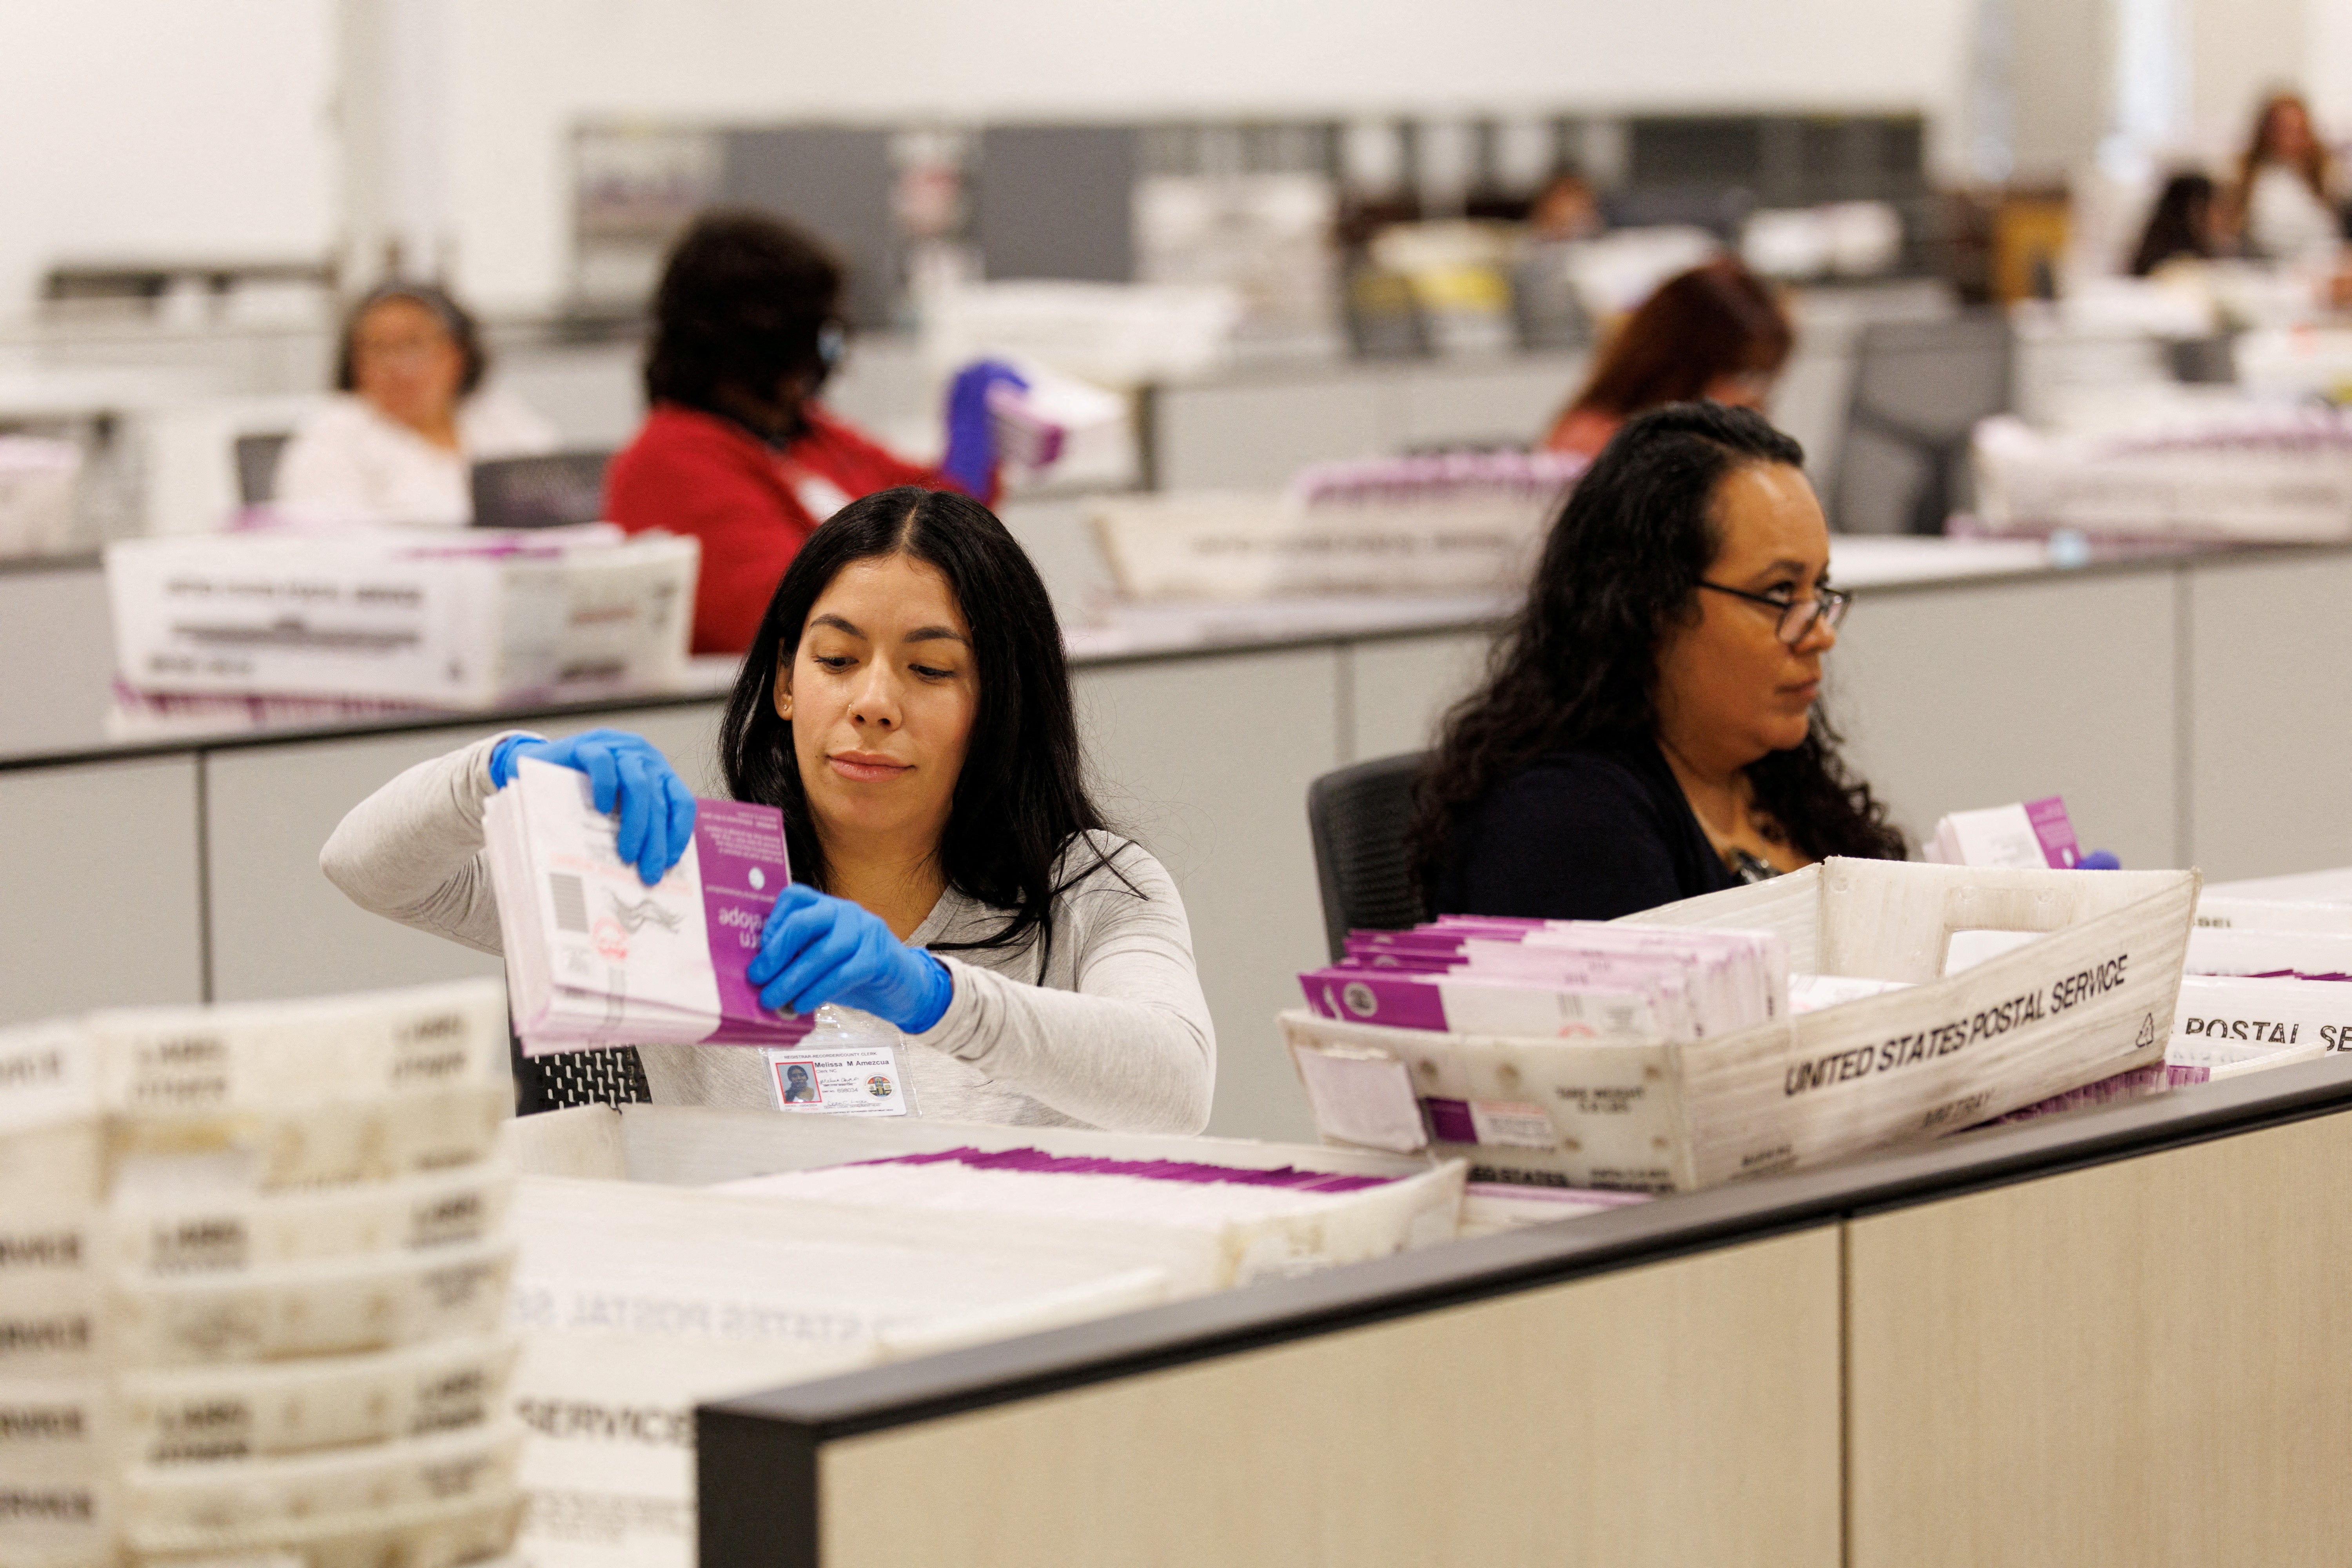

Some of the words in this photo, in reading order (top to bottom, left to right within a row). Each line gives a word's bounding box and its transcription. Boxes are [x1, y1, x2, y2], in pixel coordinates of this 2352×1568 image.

[1785, 1044, 1874, 1096] UNITED
[1877, 1018, 1968, 1072] STATES
[1969, 989, 2047, 1045] POSTAL
[2051, 954, 2128, 1013] SERVICE
[2320, 1025, 2352, 1052] SE
